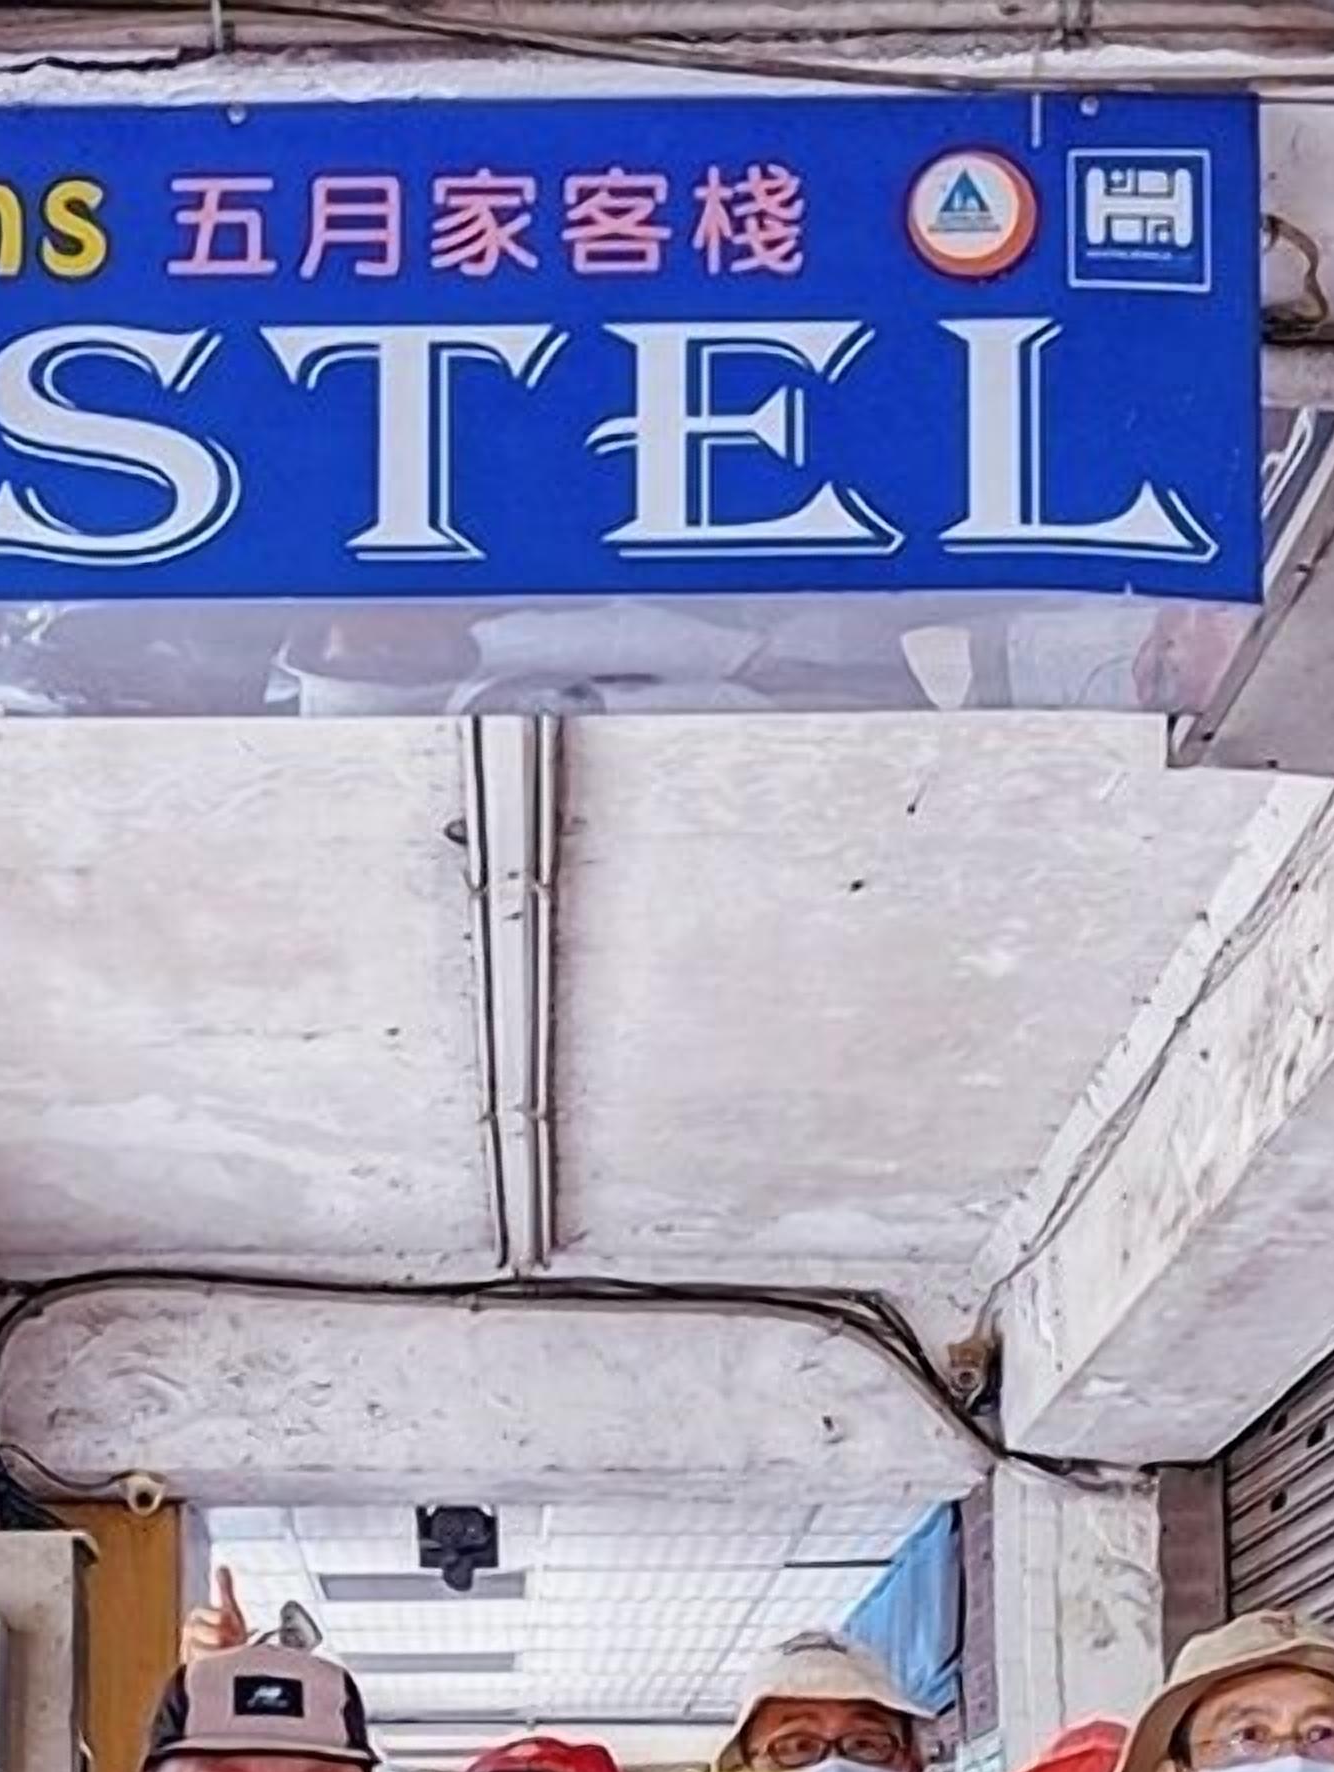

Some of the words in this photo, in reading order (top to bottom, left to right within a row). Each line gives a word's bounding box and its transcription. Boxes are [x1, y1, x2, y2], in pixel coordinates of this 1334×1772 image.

[169, 167, 805, 279] 五月家客棧
